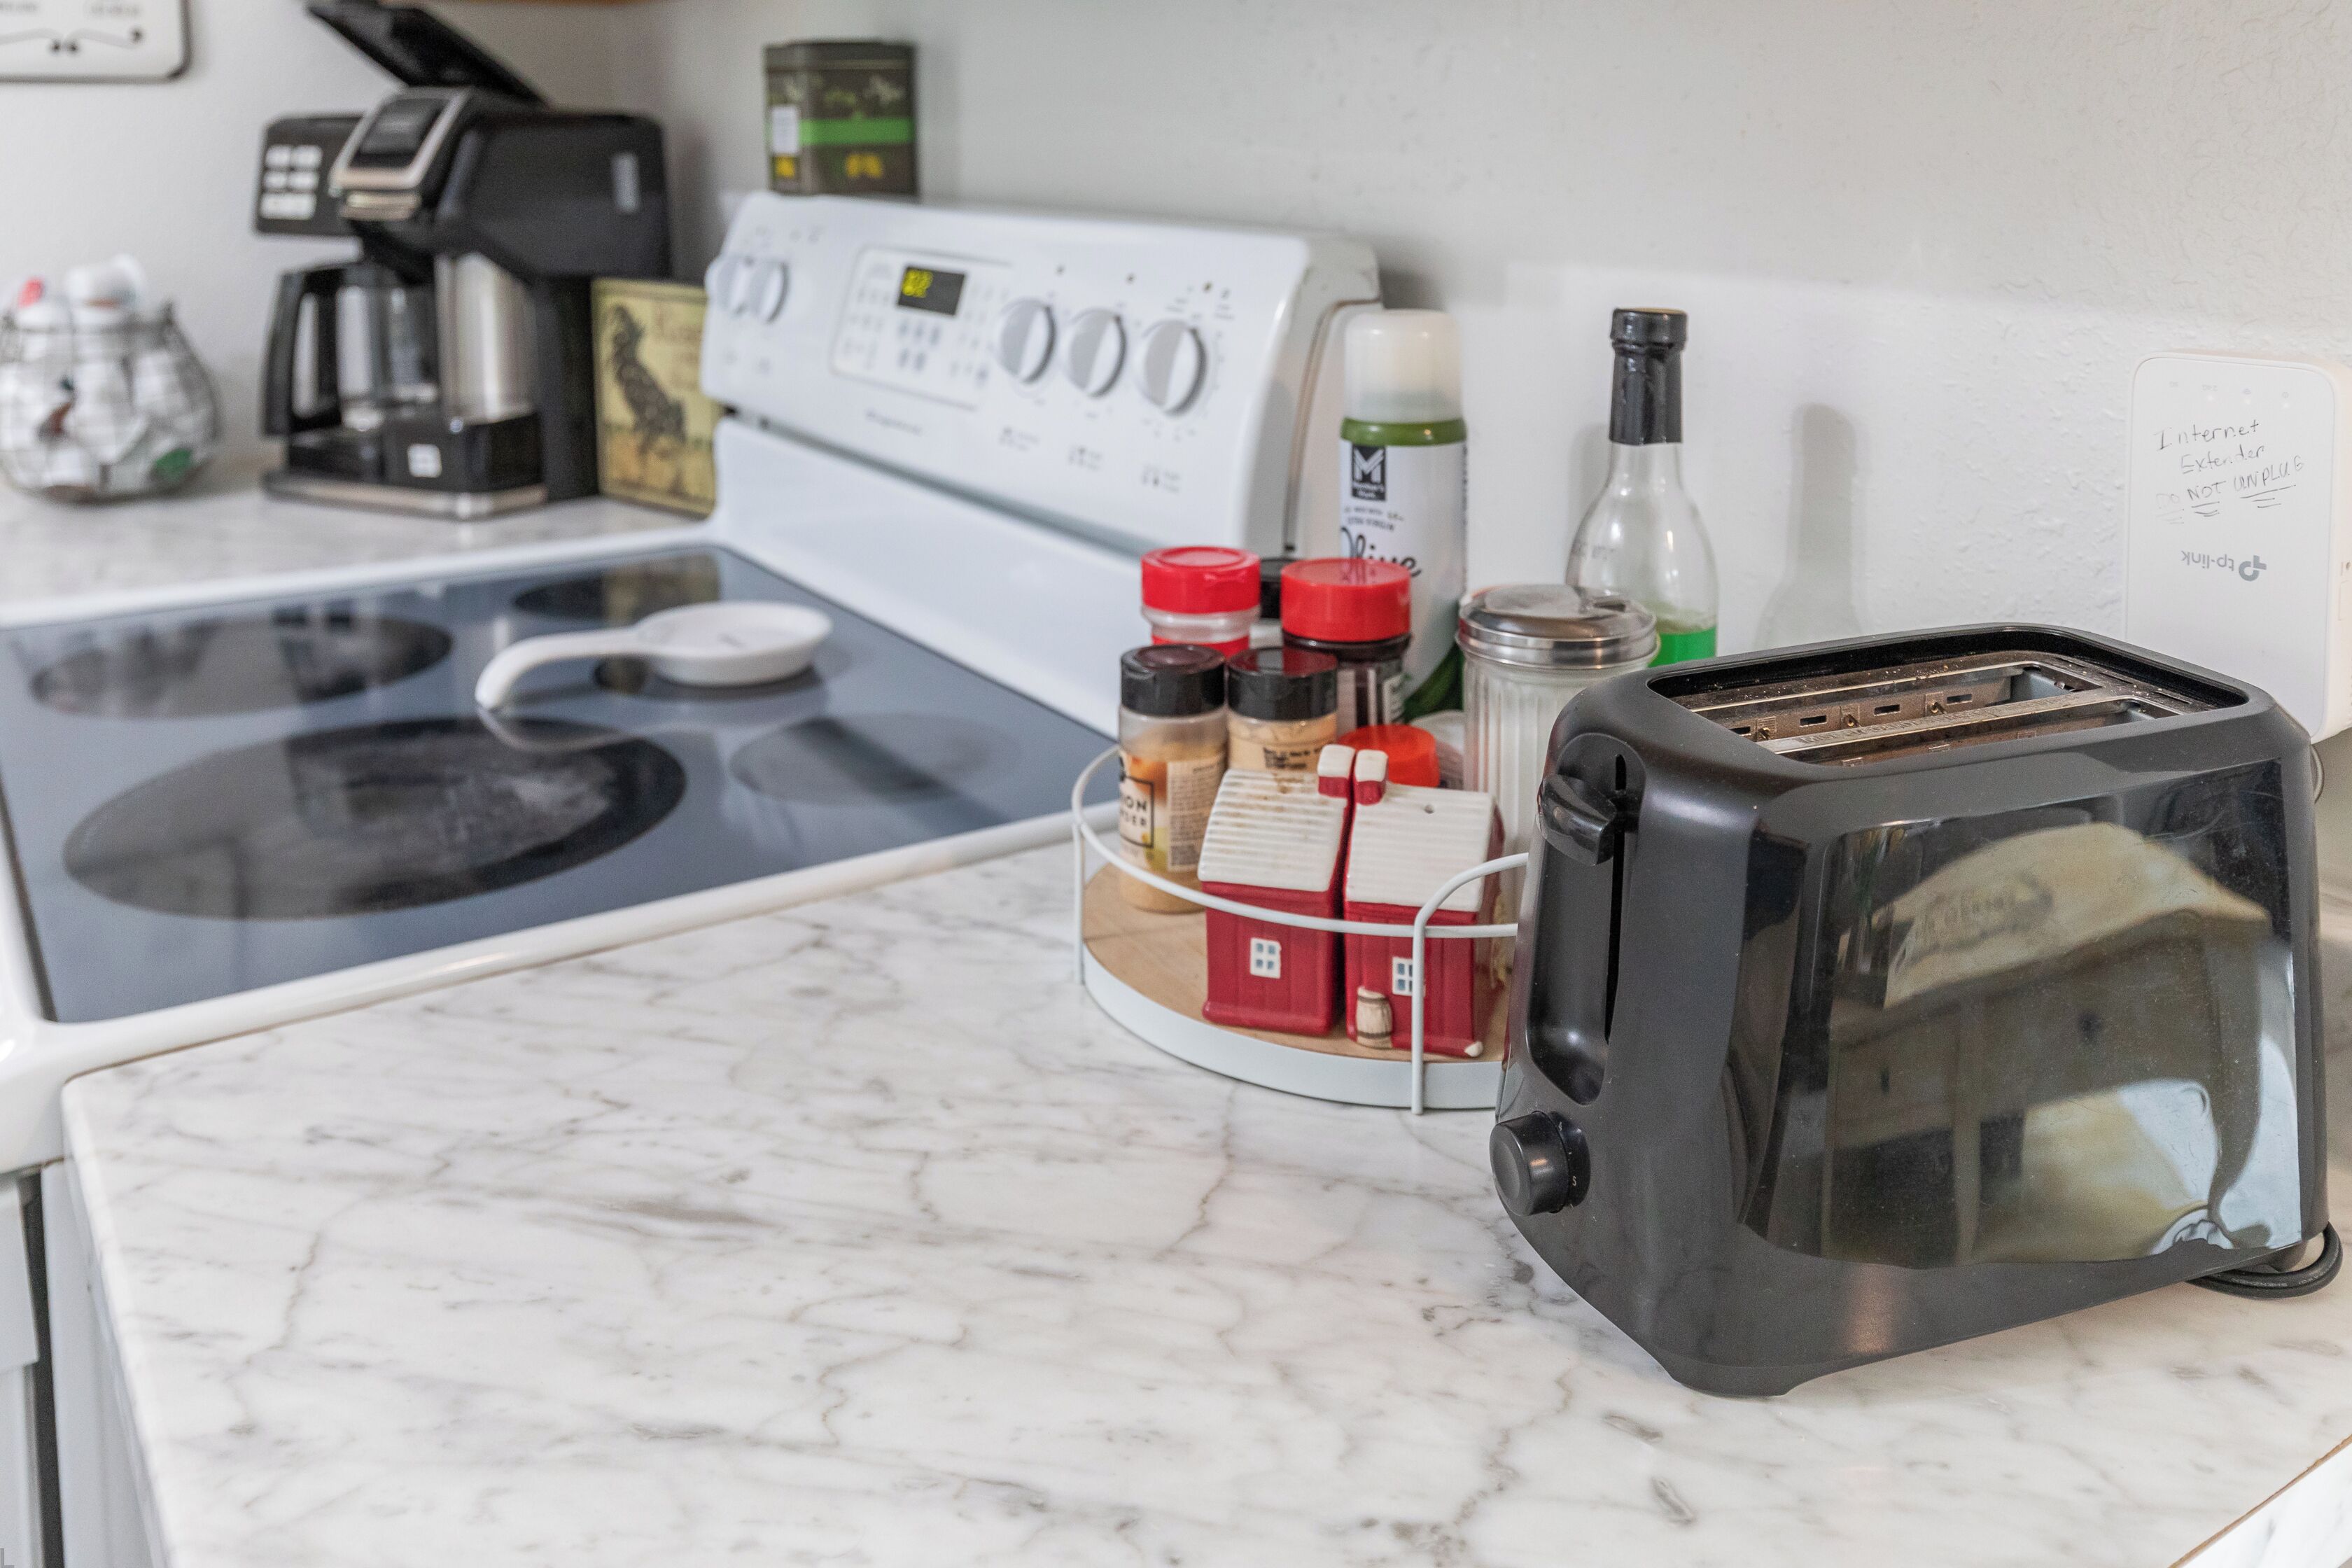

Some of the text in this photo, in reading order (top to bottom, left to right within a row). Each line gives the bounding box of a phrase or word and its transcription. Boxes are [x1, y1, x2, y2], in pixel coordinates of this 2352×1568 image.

[2153, 419, 2260, 450] Internet
[2180, 444, 2264, 474] Extender
[2187, 480, 2227, 500] NOT
[2234, 455, 2304, 491] UNPLUG
[2180, 550, 2235, 572] tp-link
